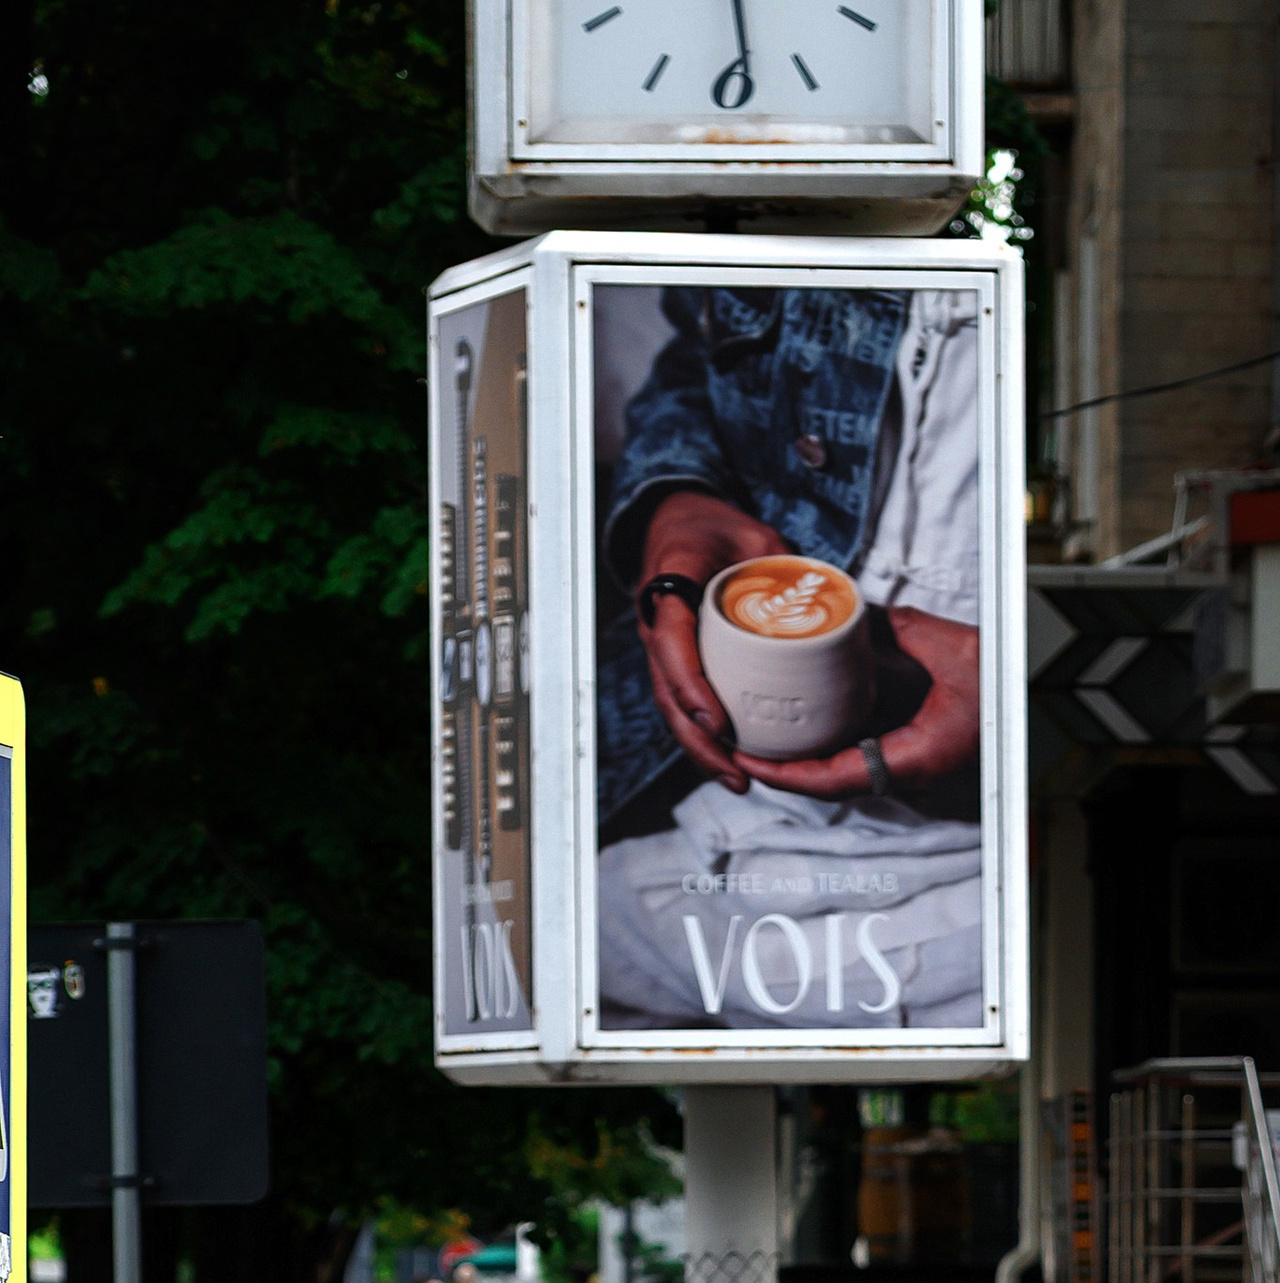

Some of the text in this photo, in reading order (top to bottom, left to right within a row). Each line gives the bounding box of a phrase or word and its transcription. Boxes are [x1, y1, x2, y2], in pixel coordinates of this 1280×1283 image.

[712, 50, 753, 109] 6
[682, 873, 764, 895] COFFEE
[682, 913, 899, 1014] VOIS
